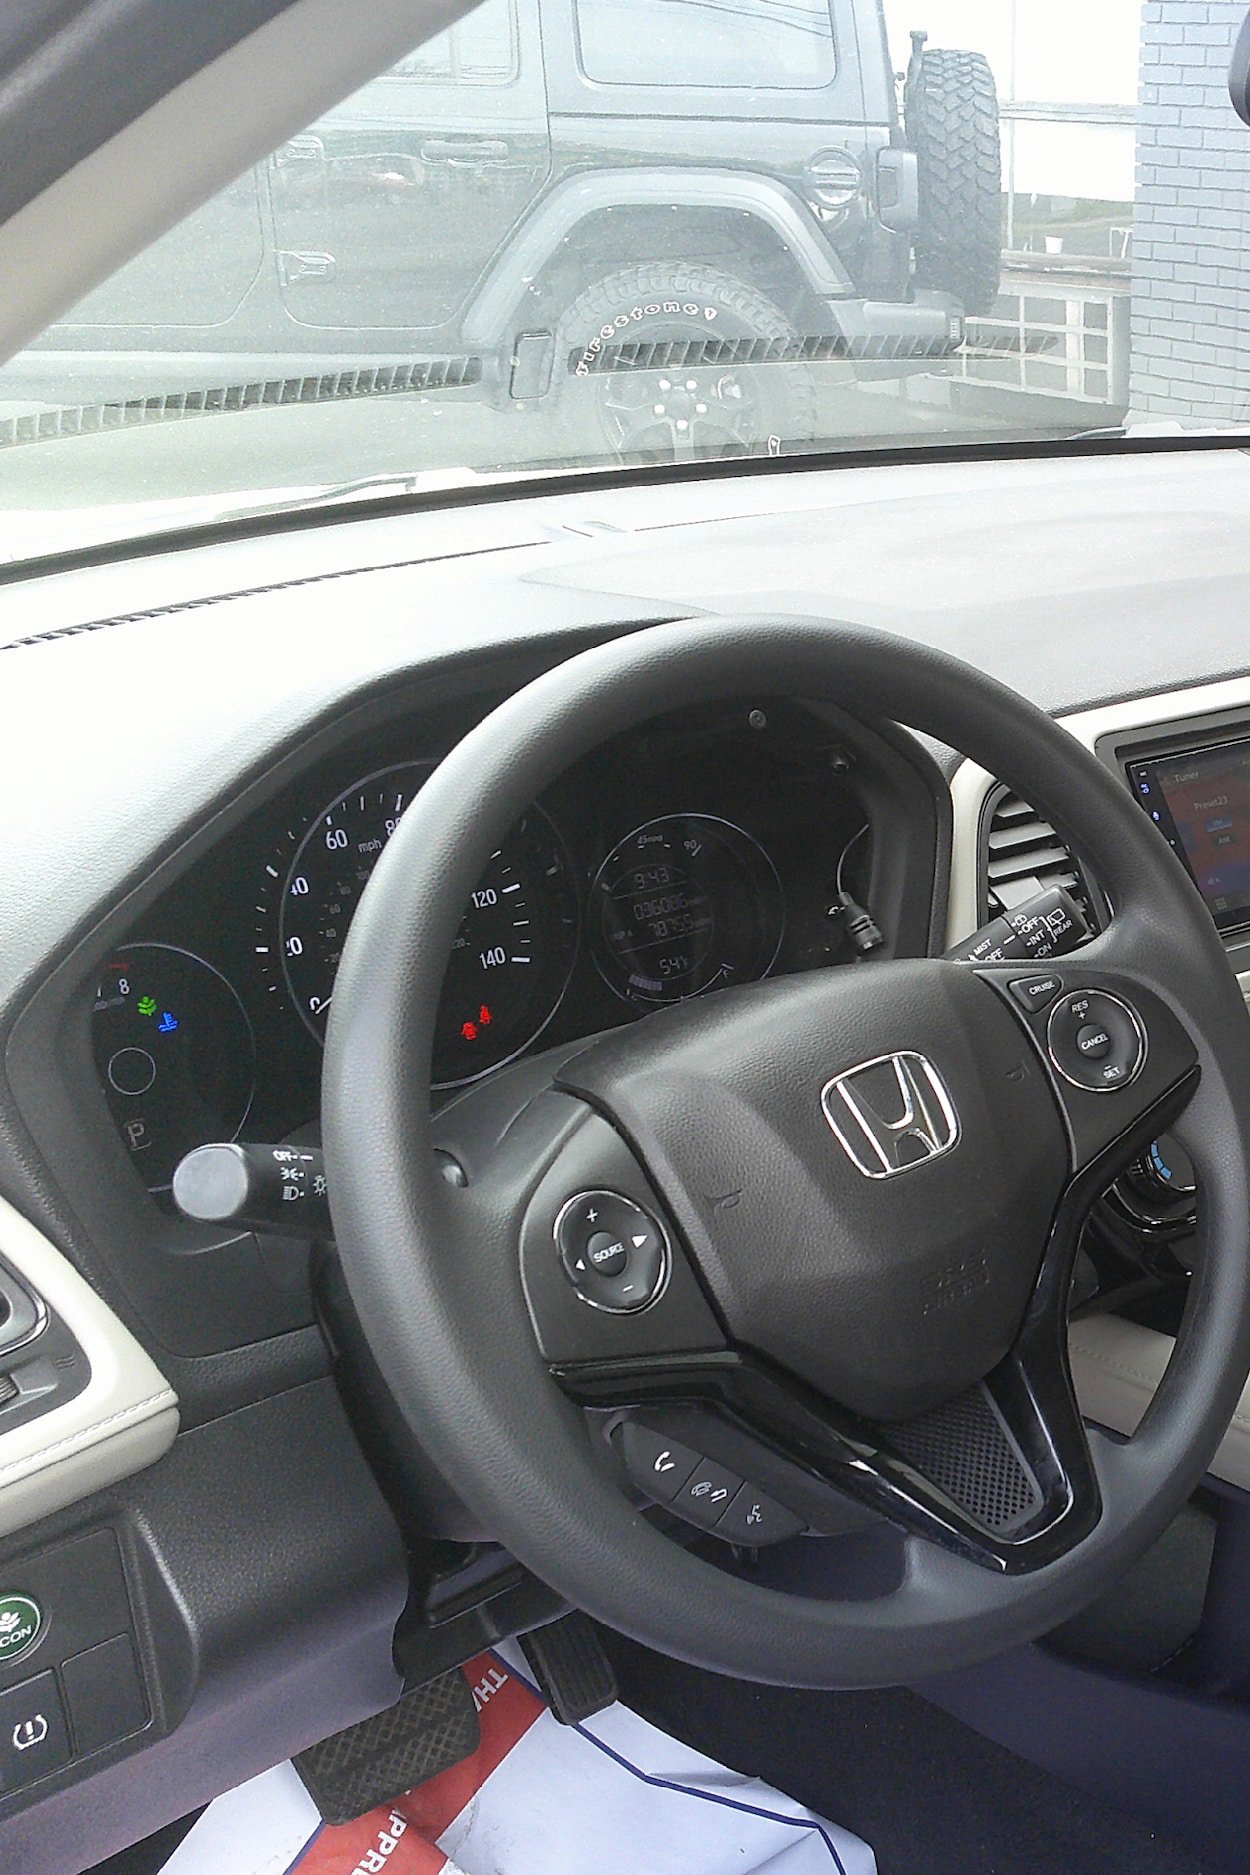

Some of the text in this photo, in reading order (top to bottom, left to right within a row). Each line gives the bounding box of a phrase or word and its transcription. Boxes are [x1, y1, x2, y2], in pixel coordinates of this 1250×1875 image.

[326, 829, 349, 850] 60
[358, 838, 383, 854] mph
[470, 888, 497, 909] 120
[1021, 916, 1041, 934] OFF
[1053, 919, 1073, 937] REAR
[1030, 929, 1046, 946] INT
[973, 938, 992, 956] MIST
[1037, 942, 1053, 957] ON
[479, 946, 506, 969] 140
[119, 978, 130, 995] 8
[1028, 980, 1056, 996] CRUISE
[1071, 999, 1089, 1014] RES
[1081, 1033, 1109, 1050] CANCEL
[1103, 1066, 1121, 1079] SET
[593, 1242, 625, 1264] SOURCE
[0, 1624, 32, 1648] CON
